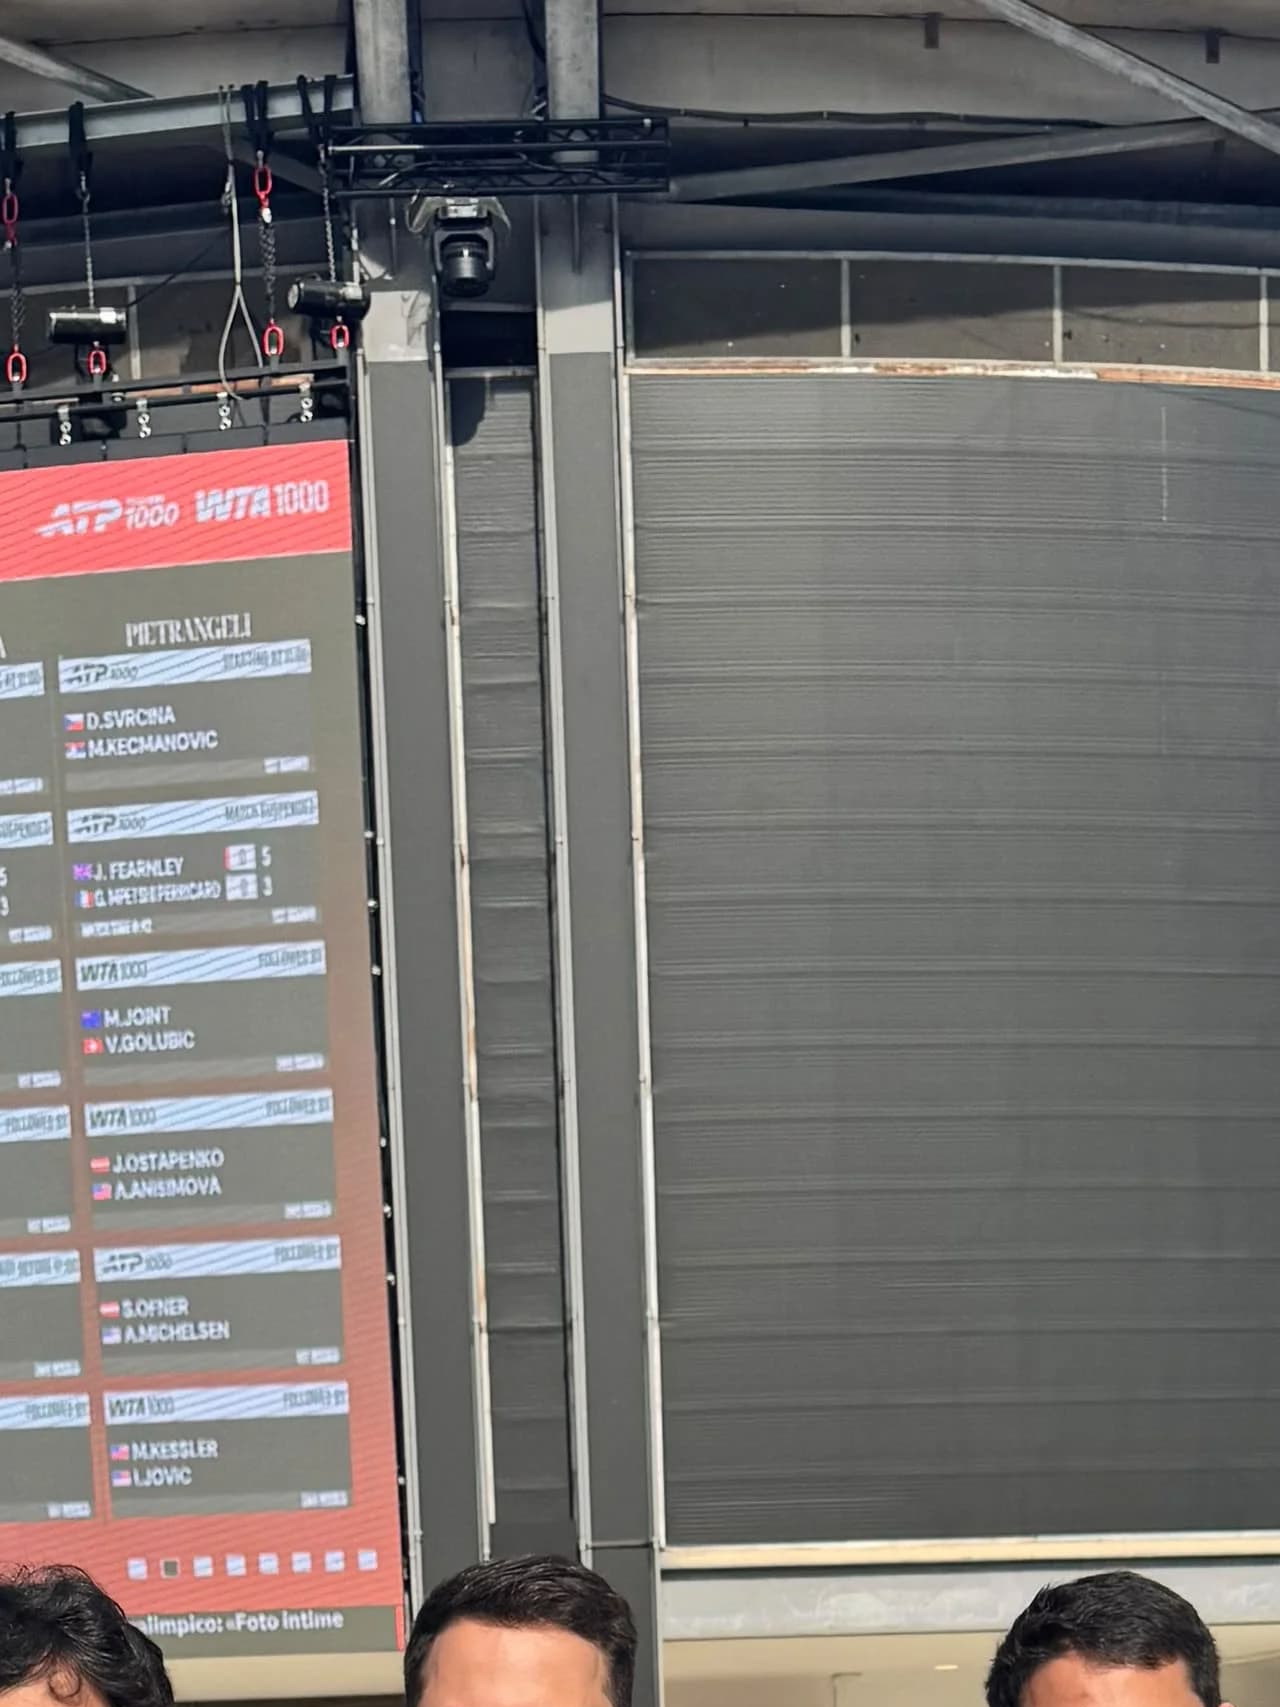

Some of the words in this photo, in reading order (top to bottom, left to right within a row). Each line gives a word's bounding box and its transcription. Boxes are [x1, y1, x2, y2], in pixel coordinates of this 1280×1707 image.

[276, 480, 329, 515] 1000
[125, 503, 179, 530] 1000
[125, 612, 251, 647] PIETRANGELI
[86, 705, 176, 730] D.SVRCINA
[88, 730, 218, 758] M.KECMANOVIC
[110, 857, 184, 880] FEARNLEY
[261, 846, 271, 866] 5
[0, 896, 9, 916] 3
[104, 1006, 171, 1027] M.JOINT
[105, 1030, 195, 1054] V.GOLUBIC
[112, 1147, 224, 1173] J.OSTAPENKO
[114, 1175, 221, 1200] A.ANISIMOVA
[122, 1296, 189, 1318] S.OFNER
[124, 1321, 230, 1344] A.MICHELSEN
[131, 1438, 218, 1461] M.KESSLER
[282, 1609, 344, 1631] intime
